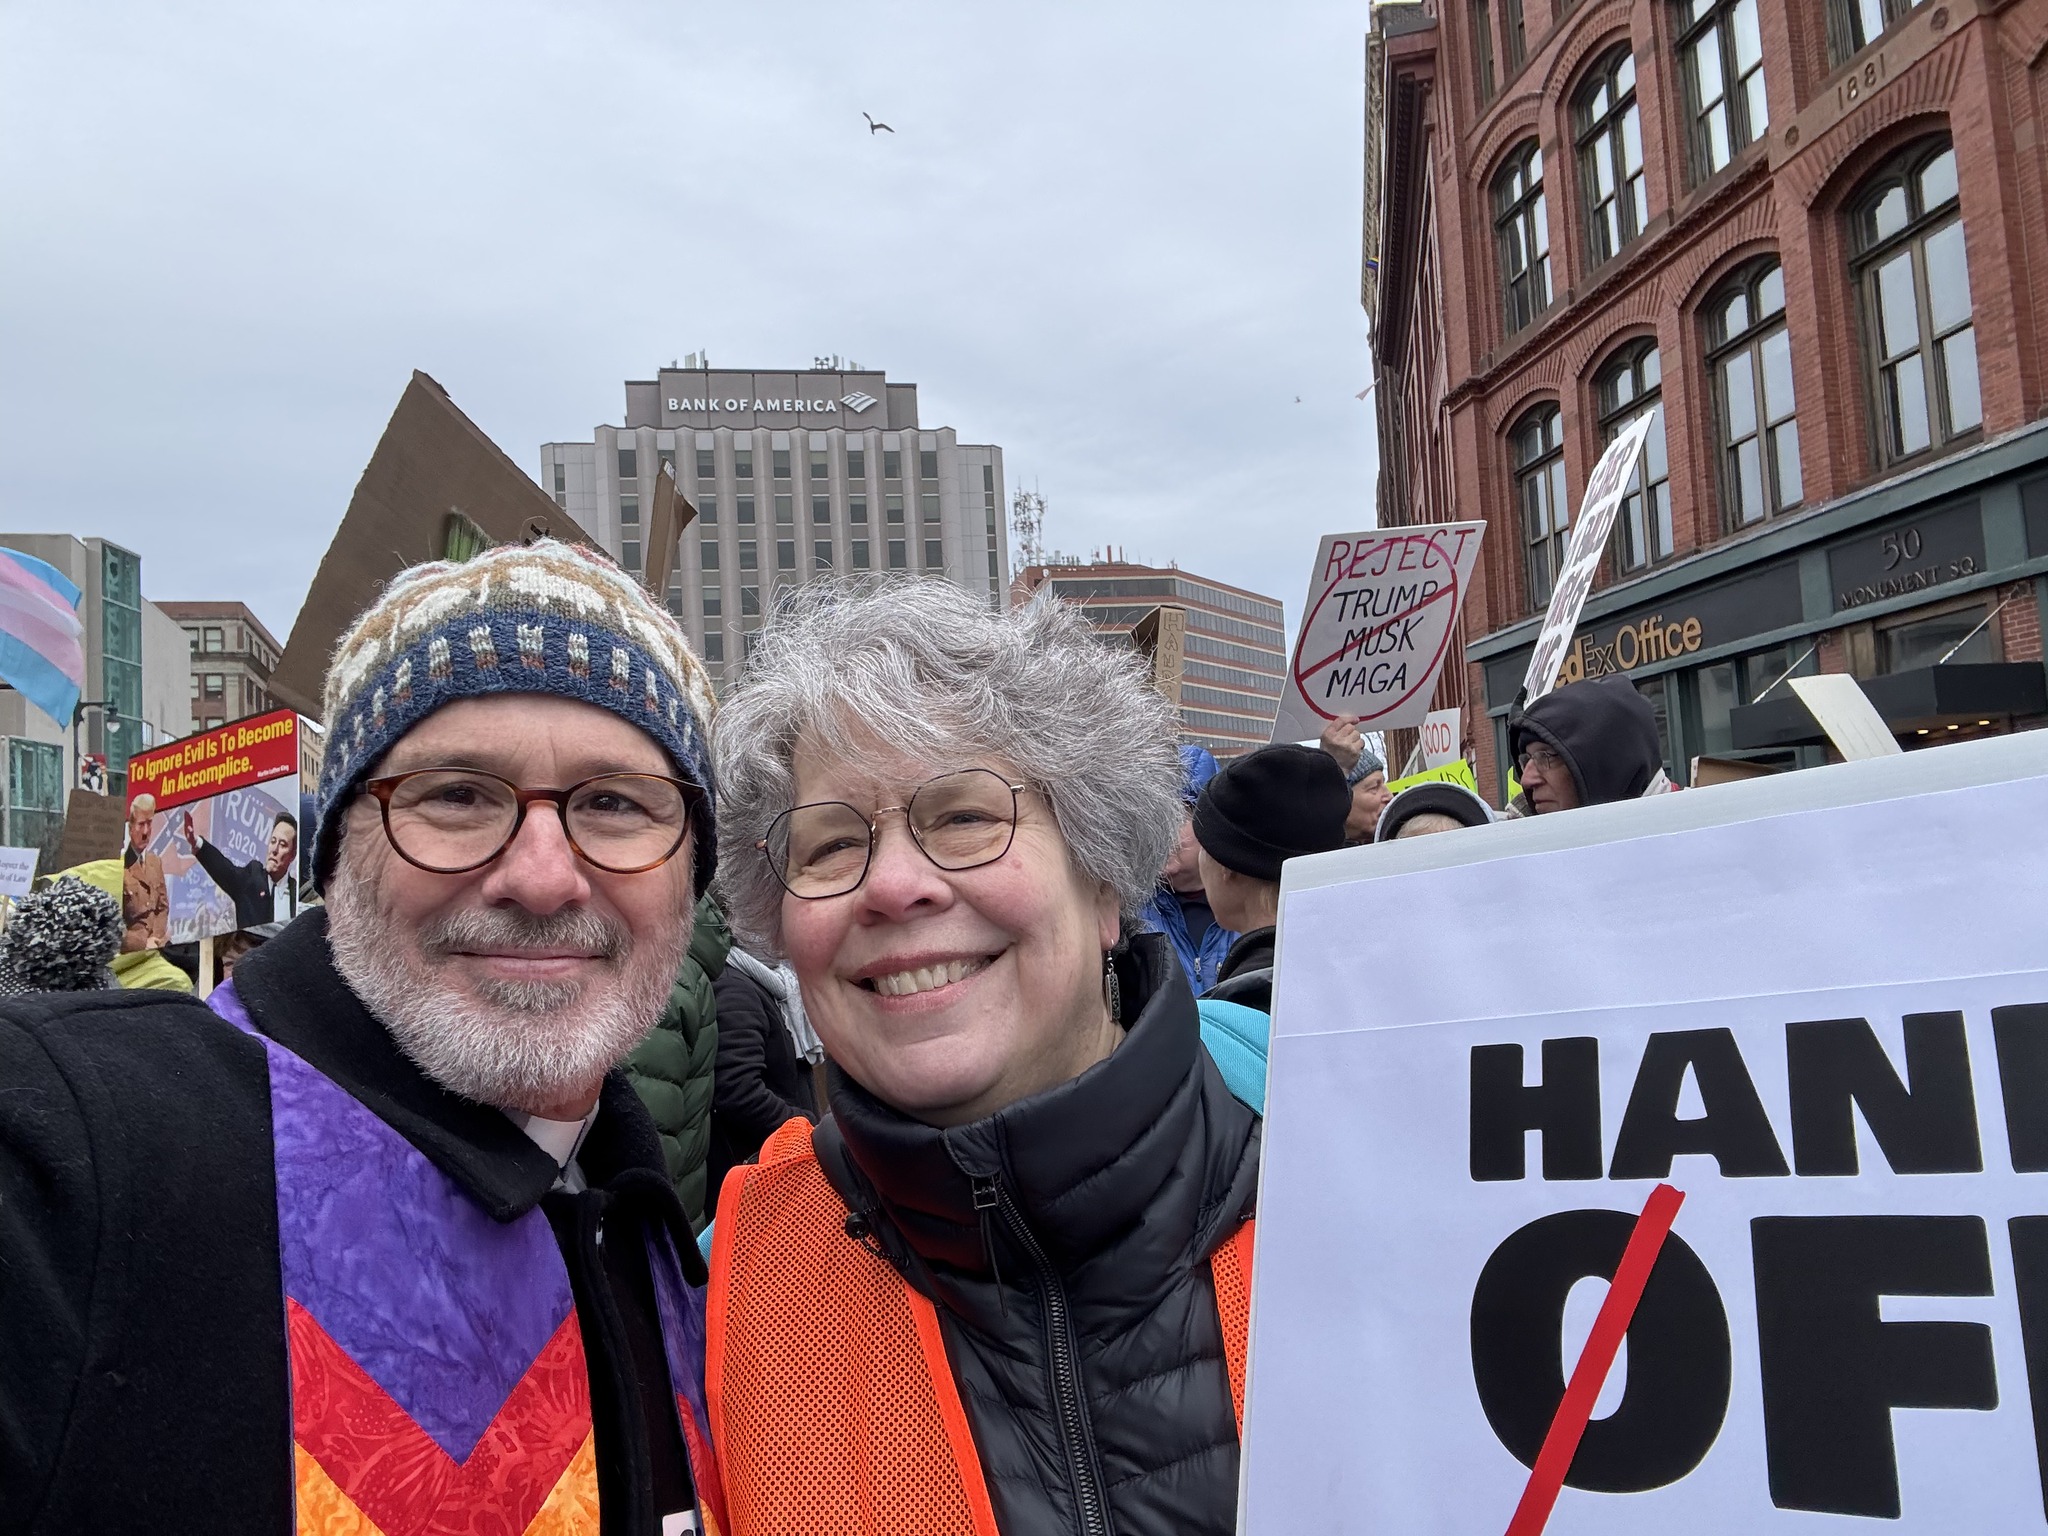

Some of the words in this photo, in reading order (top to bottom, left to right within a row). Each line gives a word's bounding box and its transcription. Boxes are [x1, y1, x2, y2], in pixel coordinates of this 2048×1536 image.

[1838, 53, 1886, 110] 1881
[668, 398, 720, 412] BANK
[724, 398, 749, 412] OF
[753, 399, 837, 413] AMERICA
[1323, 528, 1476, 582] REJECT
[1881, 527, 1922, 571] 50
[1332, 580, 1438, 622] TRUMP
[1840, 565, 1941, 610] MONUMENT
[1949, 556, 1979, 577] SQ.
[1339, 616, 1424, 662] MUSK
[1554, 633, 1617, 689] edEx
[1616, 614, 1702, 670] Office
[1325, 662, 1408, 698] MAGA
[130, 762, 144, 783] To
[145, 752, 183, 782] Ignore
[184, 740, 204, 767] Evil
[206, 738, 218, 759] Is
[219, 733, 236, 754] To
[238, 717, 294, 749] Become
[160, 776, 176, 797] An
[177, 755, 254, 792] Accomplice.
[220, 789, 273, 845] RUM
[228, 829, 257, 858] 2020
[1470, 1208, 2048, 1524] OF
